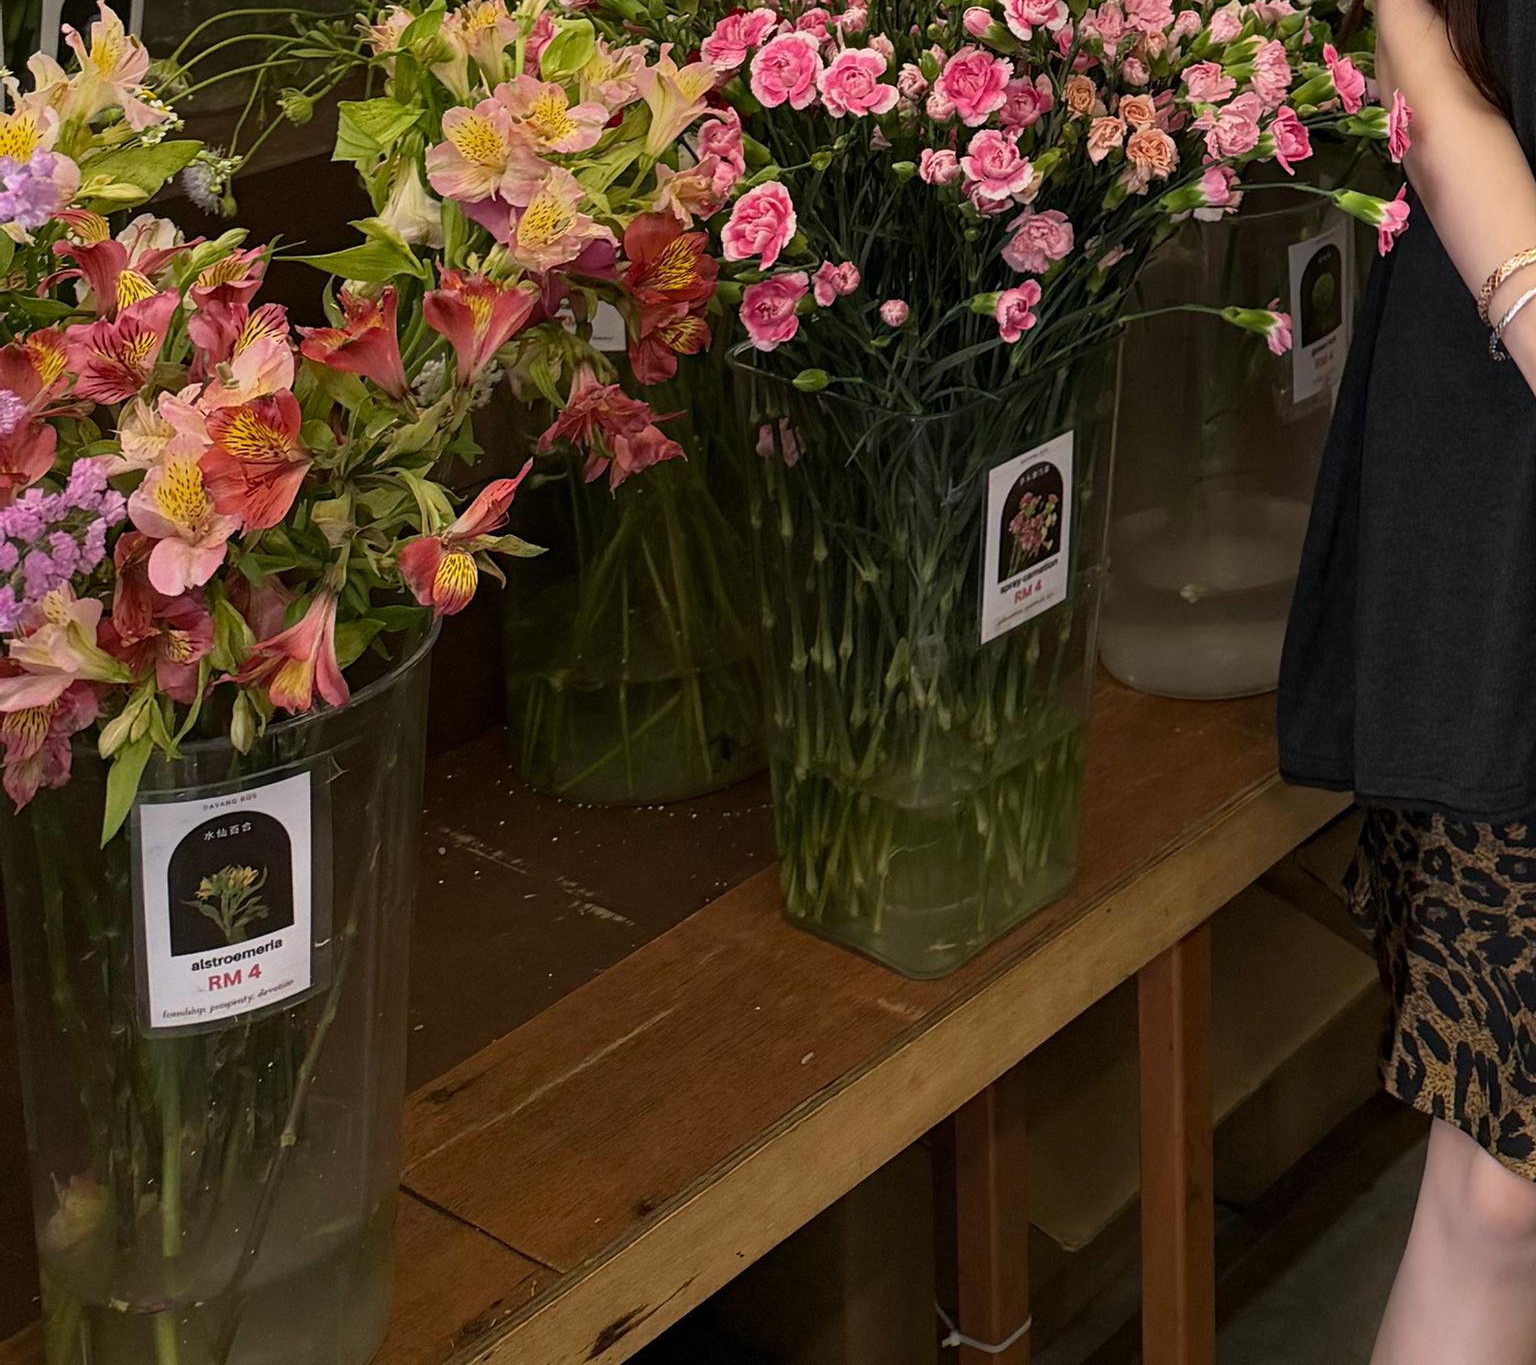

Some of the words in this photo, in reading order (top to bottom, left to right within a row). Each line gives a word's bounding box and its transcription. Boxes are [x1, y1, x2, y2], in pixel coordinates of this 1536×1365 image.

[1014, 584, 1032, 604] RM
[203, 798, 237, 811] DAYANG
[203, 822, 252, 841] 水仙百合
[191, 937, 283, 972] alstroemeria
[208, 969, 242, 992] RM
[248, 964, 262, 979] 4
